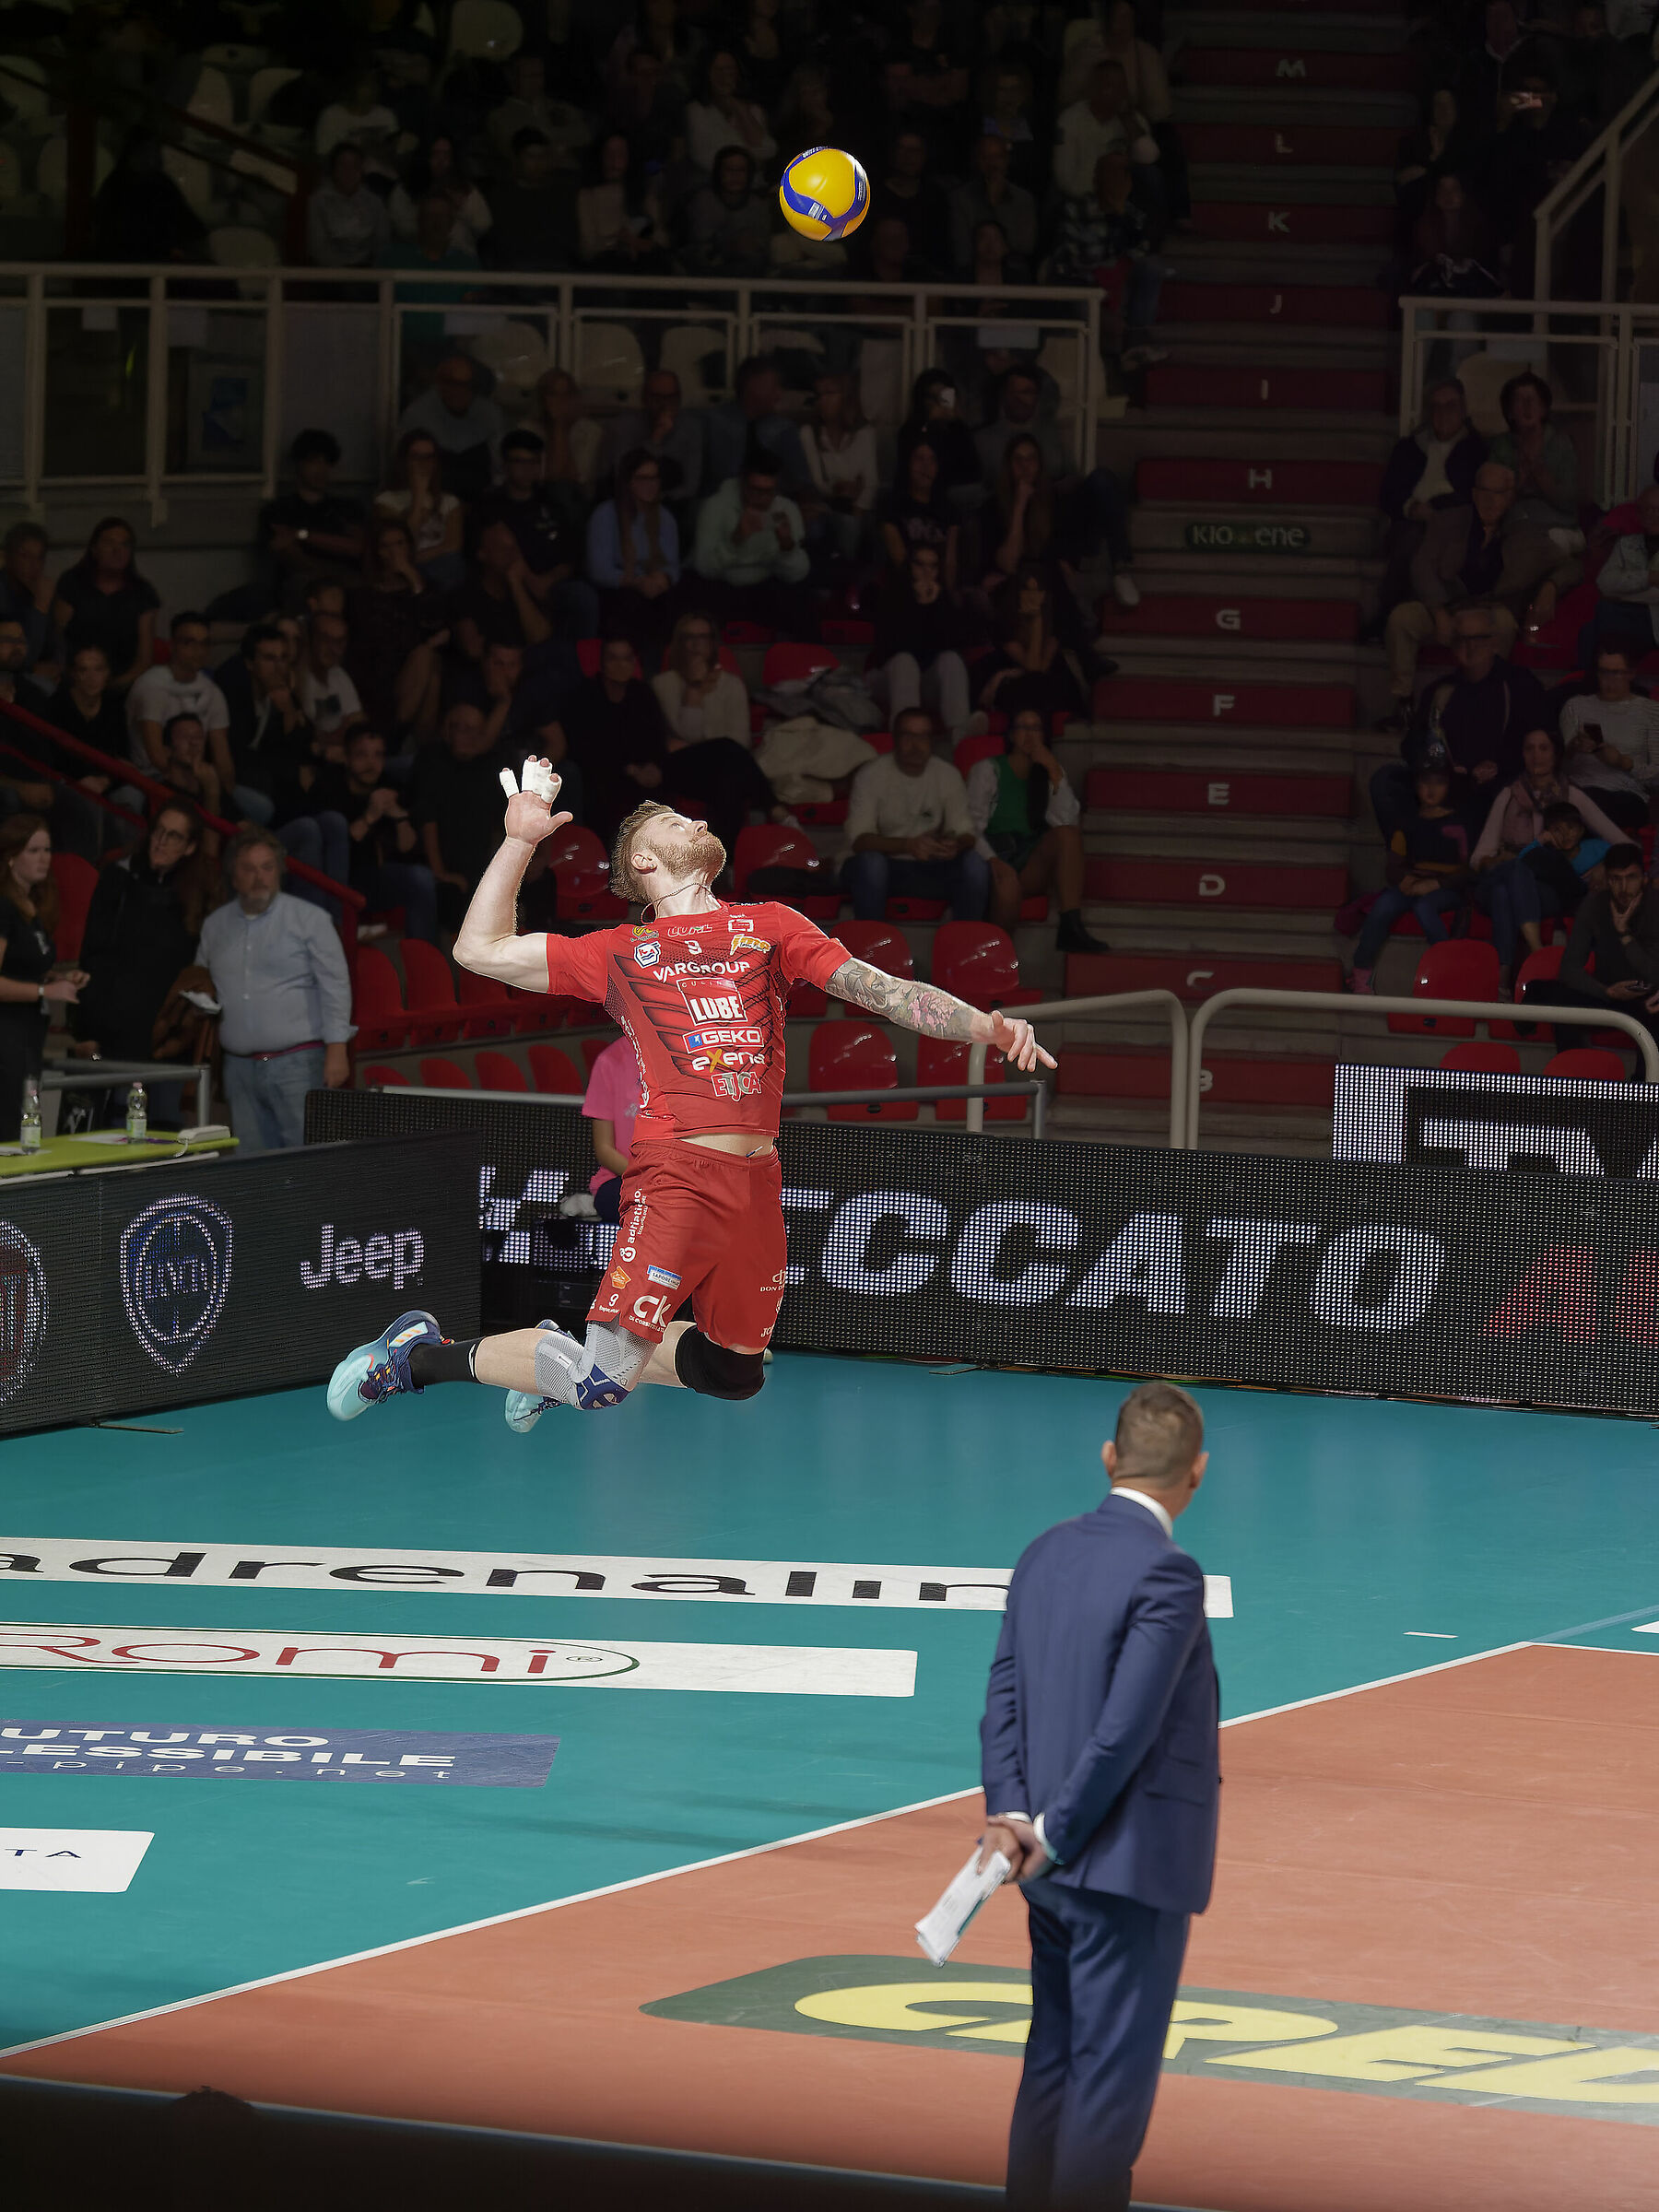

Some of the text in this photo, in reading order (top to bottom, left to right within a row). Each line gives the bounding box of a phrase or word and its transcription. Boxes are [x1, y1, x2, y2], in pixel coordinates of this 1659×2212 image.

[1276, 59, 1306, 77] M
[1276, 133, 1293, 153] L
[1268, 211, 1290, 233] K
[1269, 295, 1282, 314] J
[1261, 379, 1269, 400] I
[1248, 468, 1272, 489] H
[1216, 609, 1241, 629] G
[1213, 695, 1235, 716] F
[1207, 782, 1230, 806] E
[1198, 875, 1226, 896] D
[653, 960, 751, 983] VARGROUP
[689, 995, 743, 1021] LUBE
[701, 1030, 760, 1044] GEKO
[300, 1223, 426, 1290] Jeep
[1, 1727, 329, 1747] UTURO
[0, 1744, 456, 1768] ESSIBILE
